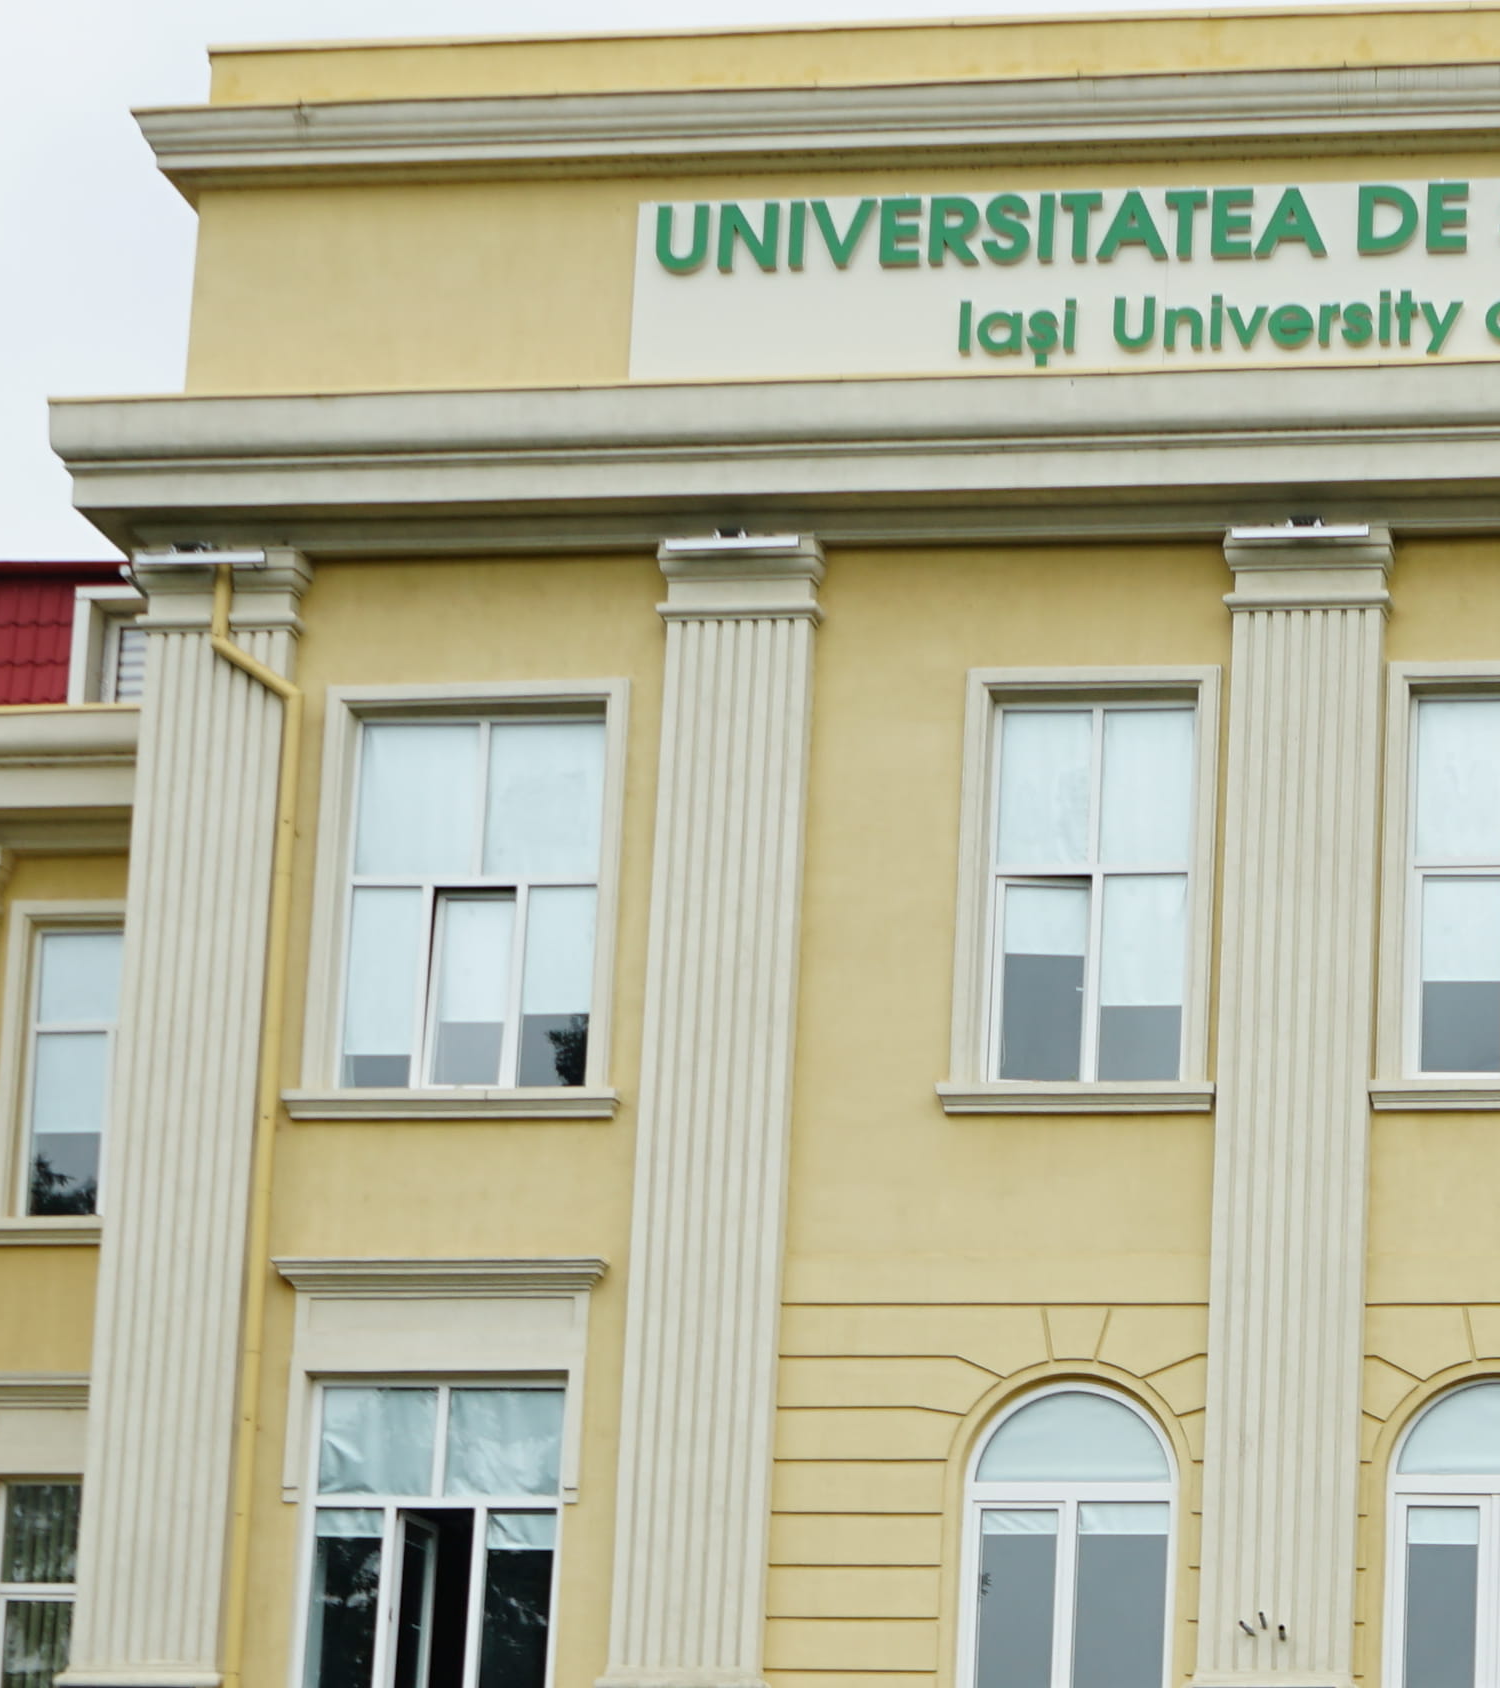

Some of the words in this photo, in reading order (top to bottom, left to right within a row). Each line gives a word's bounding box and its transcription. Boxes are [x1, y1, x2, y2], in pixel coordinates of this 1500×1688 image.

[655, 186, 1327, 274] UNIVERSITATEA
[1357, 181, 1471, 255] DE
[958, 297, 1078, 368] Iași
[1112, 288, 1464, 356] University
